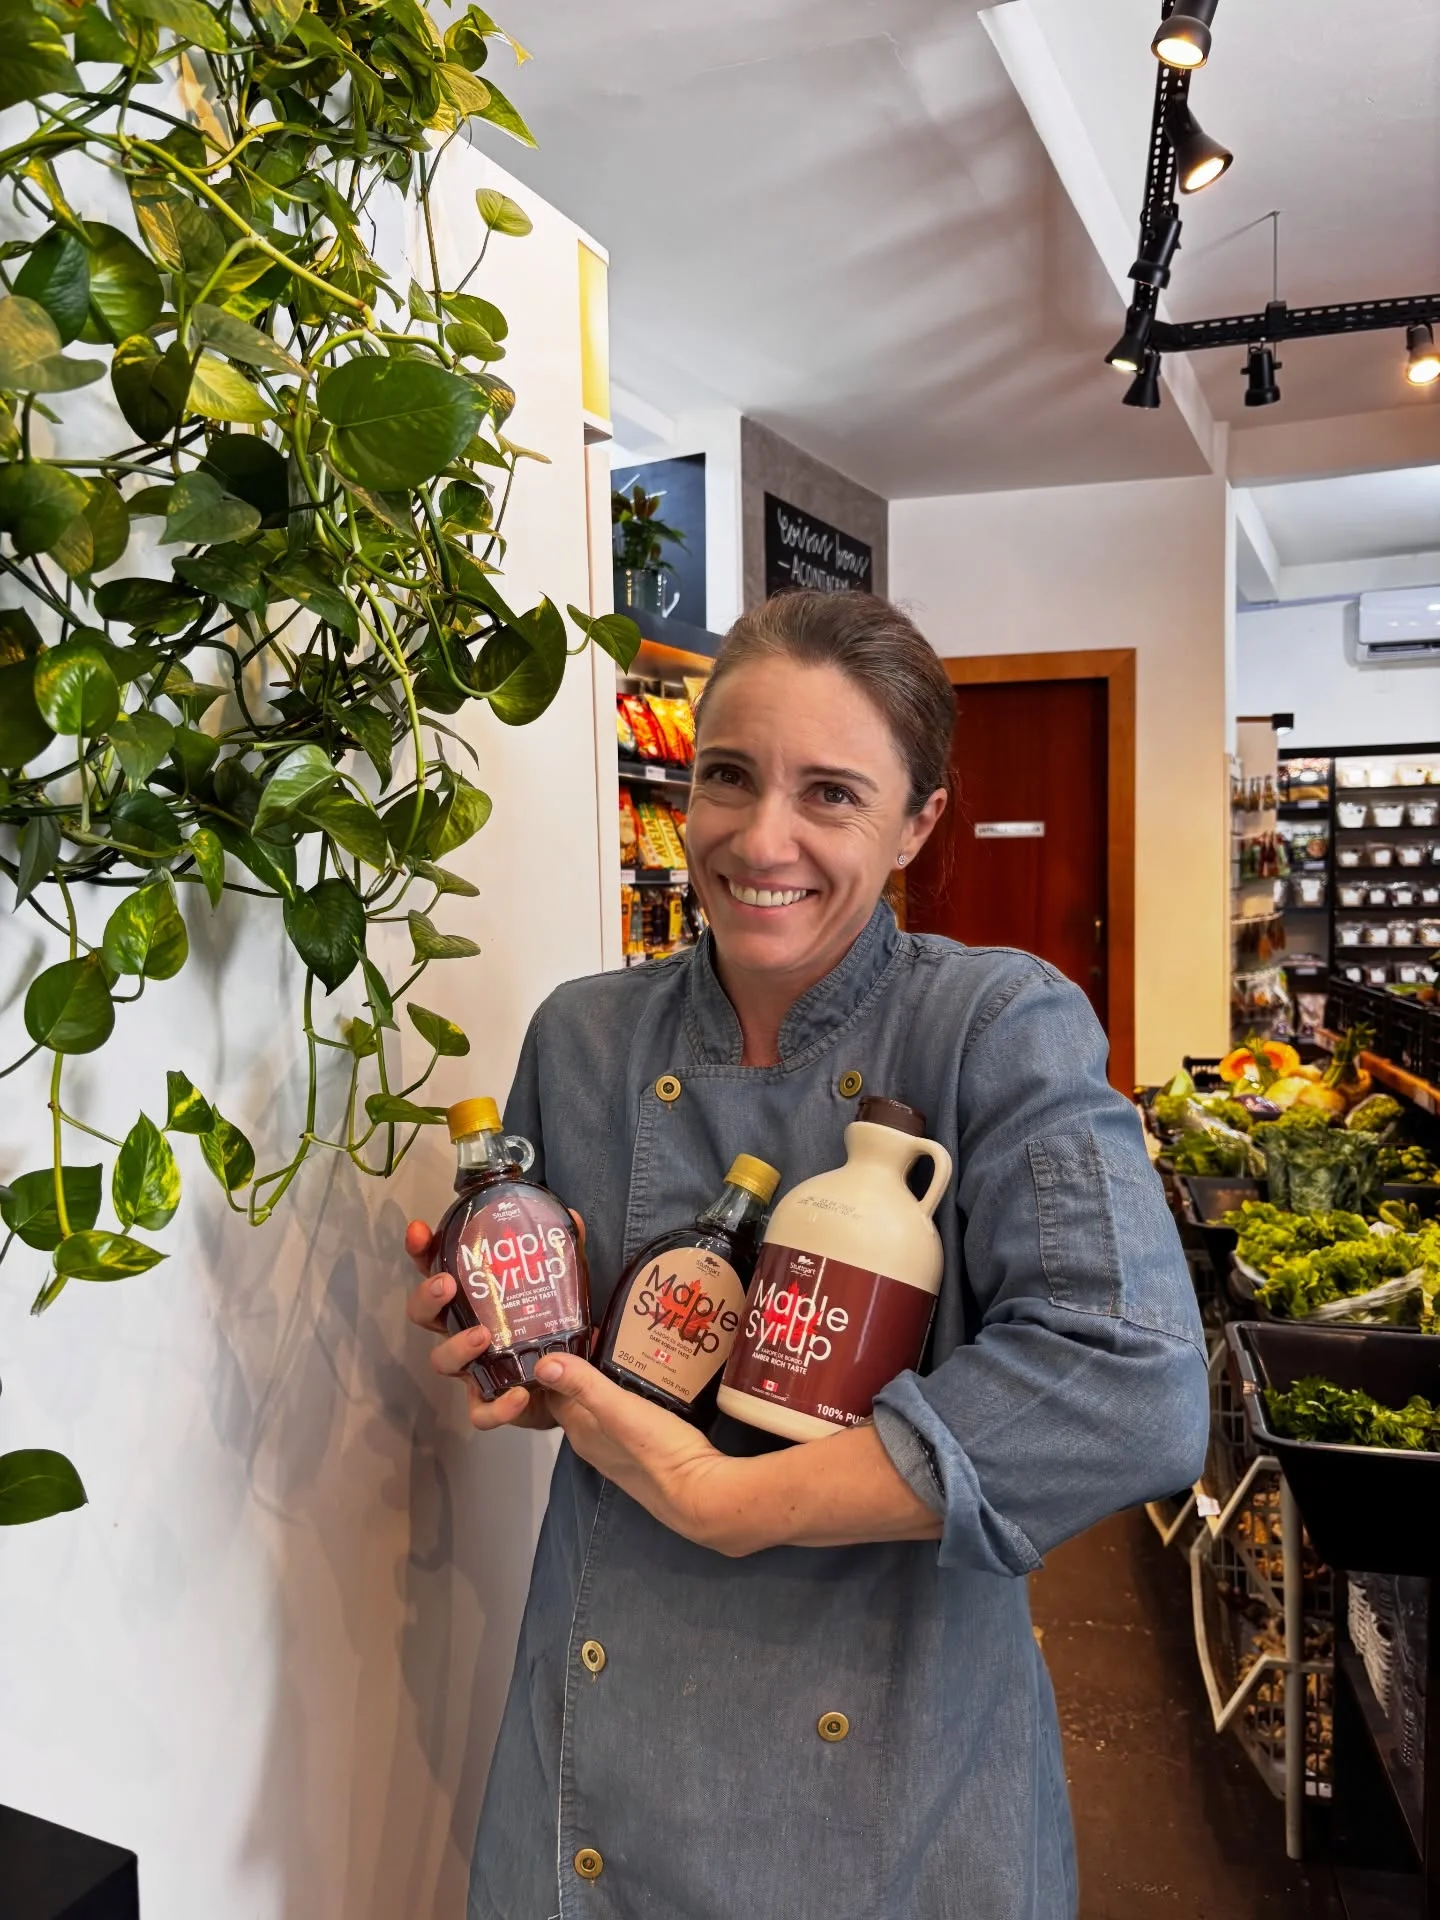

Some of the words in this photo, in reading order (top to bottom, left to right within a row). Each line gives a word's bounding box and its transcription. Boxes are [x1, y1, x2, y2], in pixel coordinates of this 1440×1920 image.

[461, 1223, 566, 1271] Maple
[790, 1261, 816, 1275] Stuttgart
[468, 1257, 566, 1303] Syrup
[522, 1296, 537, 1304] RICH
[539, 1290, 557, 1299] TASTE
[645, 1264, 739, 1332] Maple
[753, 1279, 849, 1332] Maple
[514, 1326, 526, 1336] ml
[544, 1319, 558, 1328] 100%
[633, 1290, 719, 1357] Syrup
[650, 1334, 661, 1343] DARK
[678, 1350, 689, 1360] TASTE
[745, 1310, 832, 1367] Syrup
[617, 1350, 634, 1364] 250
[635, 1361, 647, 1371] ml
[752, 1352, 770, 1362] AMBER
[771, 1357, 786, 1368] RICH
[787, 1363, 808, 1375] TASTE
[662, 1376, 675, 1387] 100%
[675, 1384, 690, 1396] PURO
[817, 1403, 843, 1420] 100%
